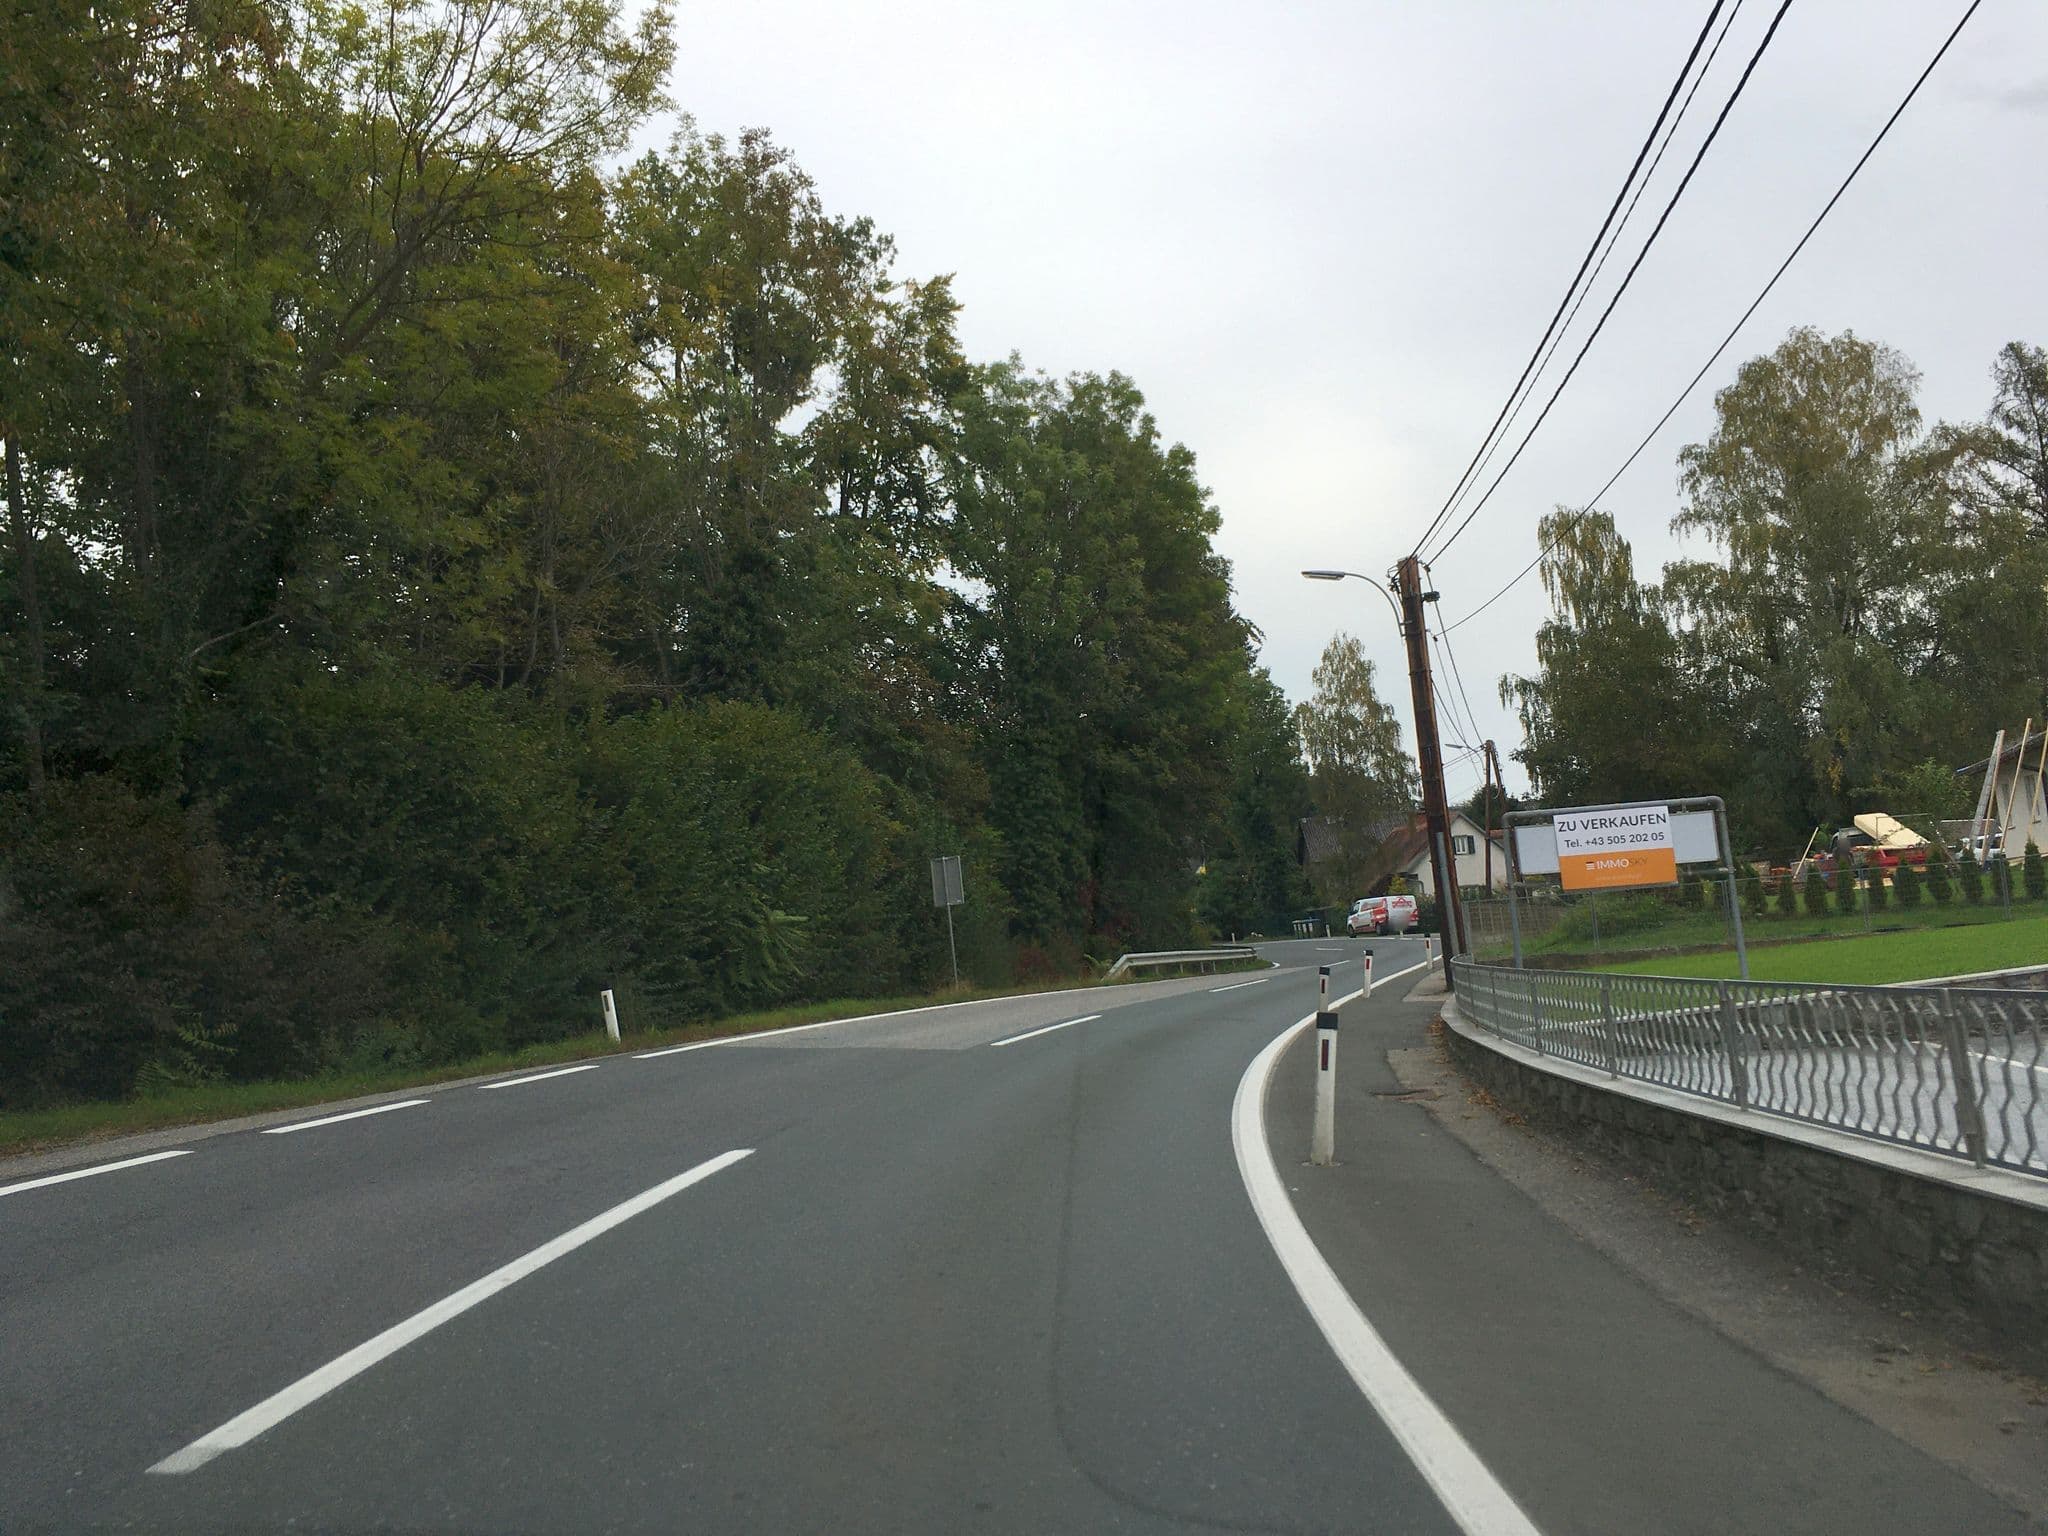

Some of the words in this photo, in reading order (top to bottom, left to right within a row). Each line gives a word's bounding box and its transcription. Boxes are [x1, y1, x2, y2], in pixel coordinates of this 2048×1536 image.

[1558, 821, 1576, 832] ZU
[1581, 813, 1667, 830] VERKAUFEN
[1565, 839, 1582, 848] Tel.
[1585, 837, 1604, 846] +43
[1607, 835, 1626, 844] 505
[1629, 833, 1648, 843] 202
[1651, 832, 1665, 841] 05
